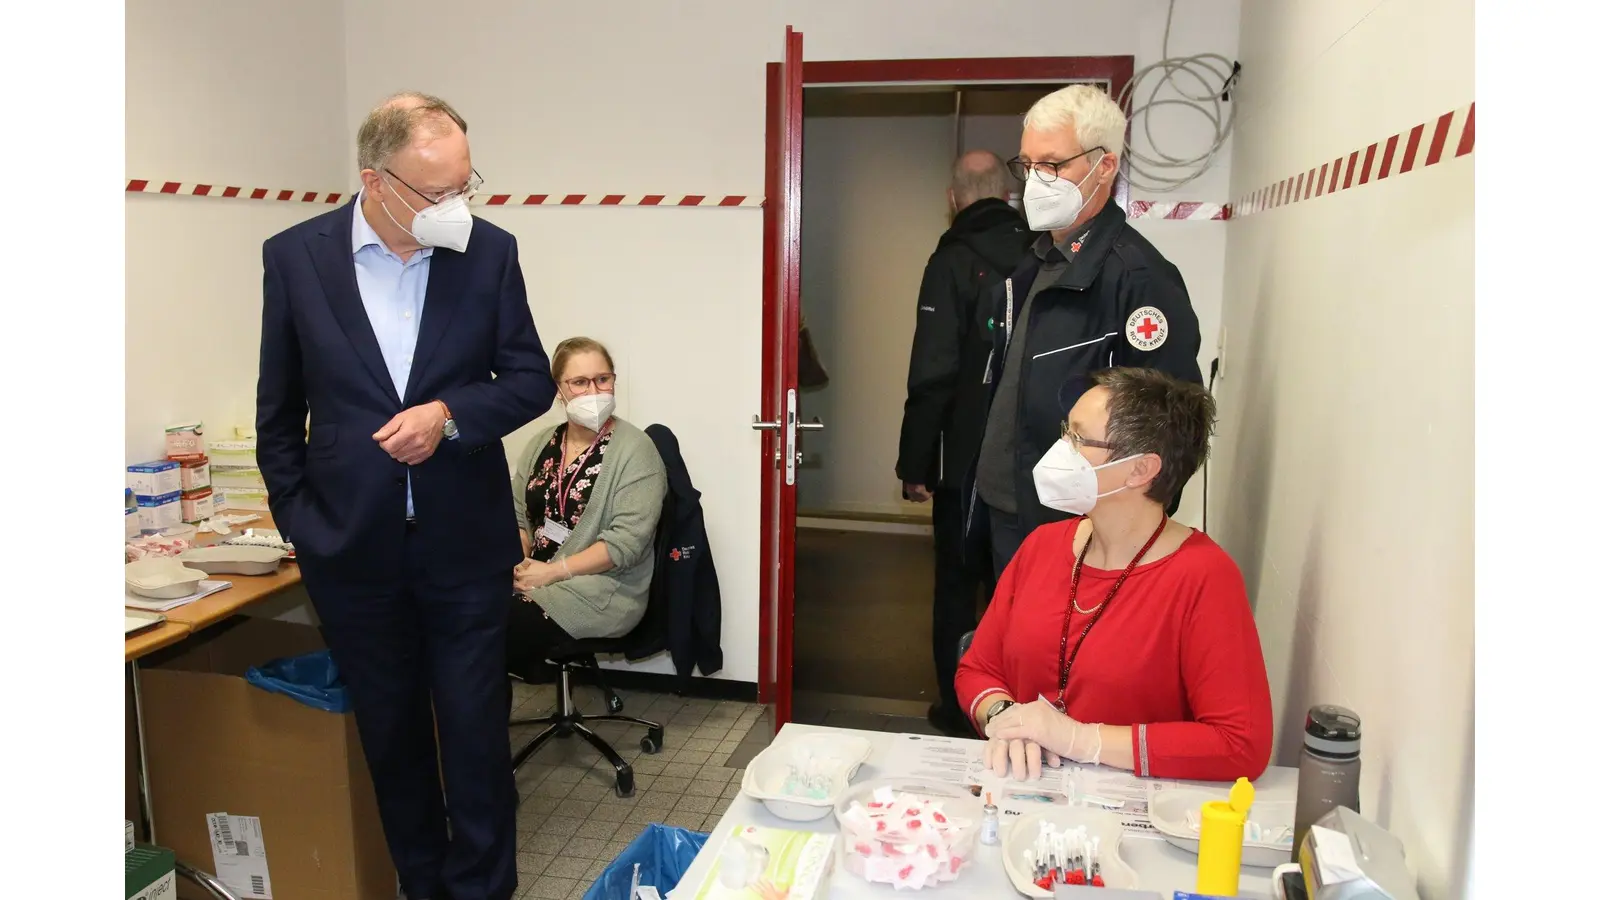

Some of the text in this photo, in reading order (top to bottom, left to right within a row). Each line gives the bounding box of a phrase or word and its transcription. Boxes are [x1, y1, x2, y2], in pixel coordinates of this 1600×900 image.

[1130, 310, 1163, 327] DEUTSCHES
[1130, 328, 1165, 347] ROTES KREUZ
